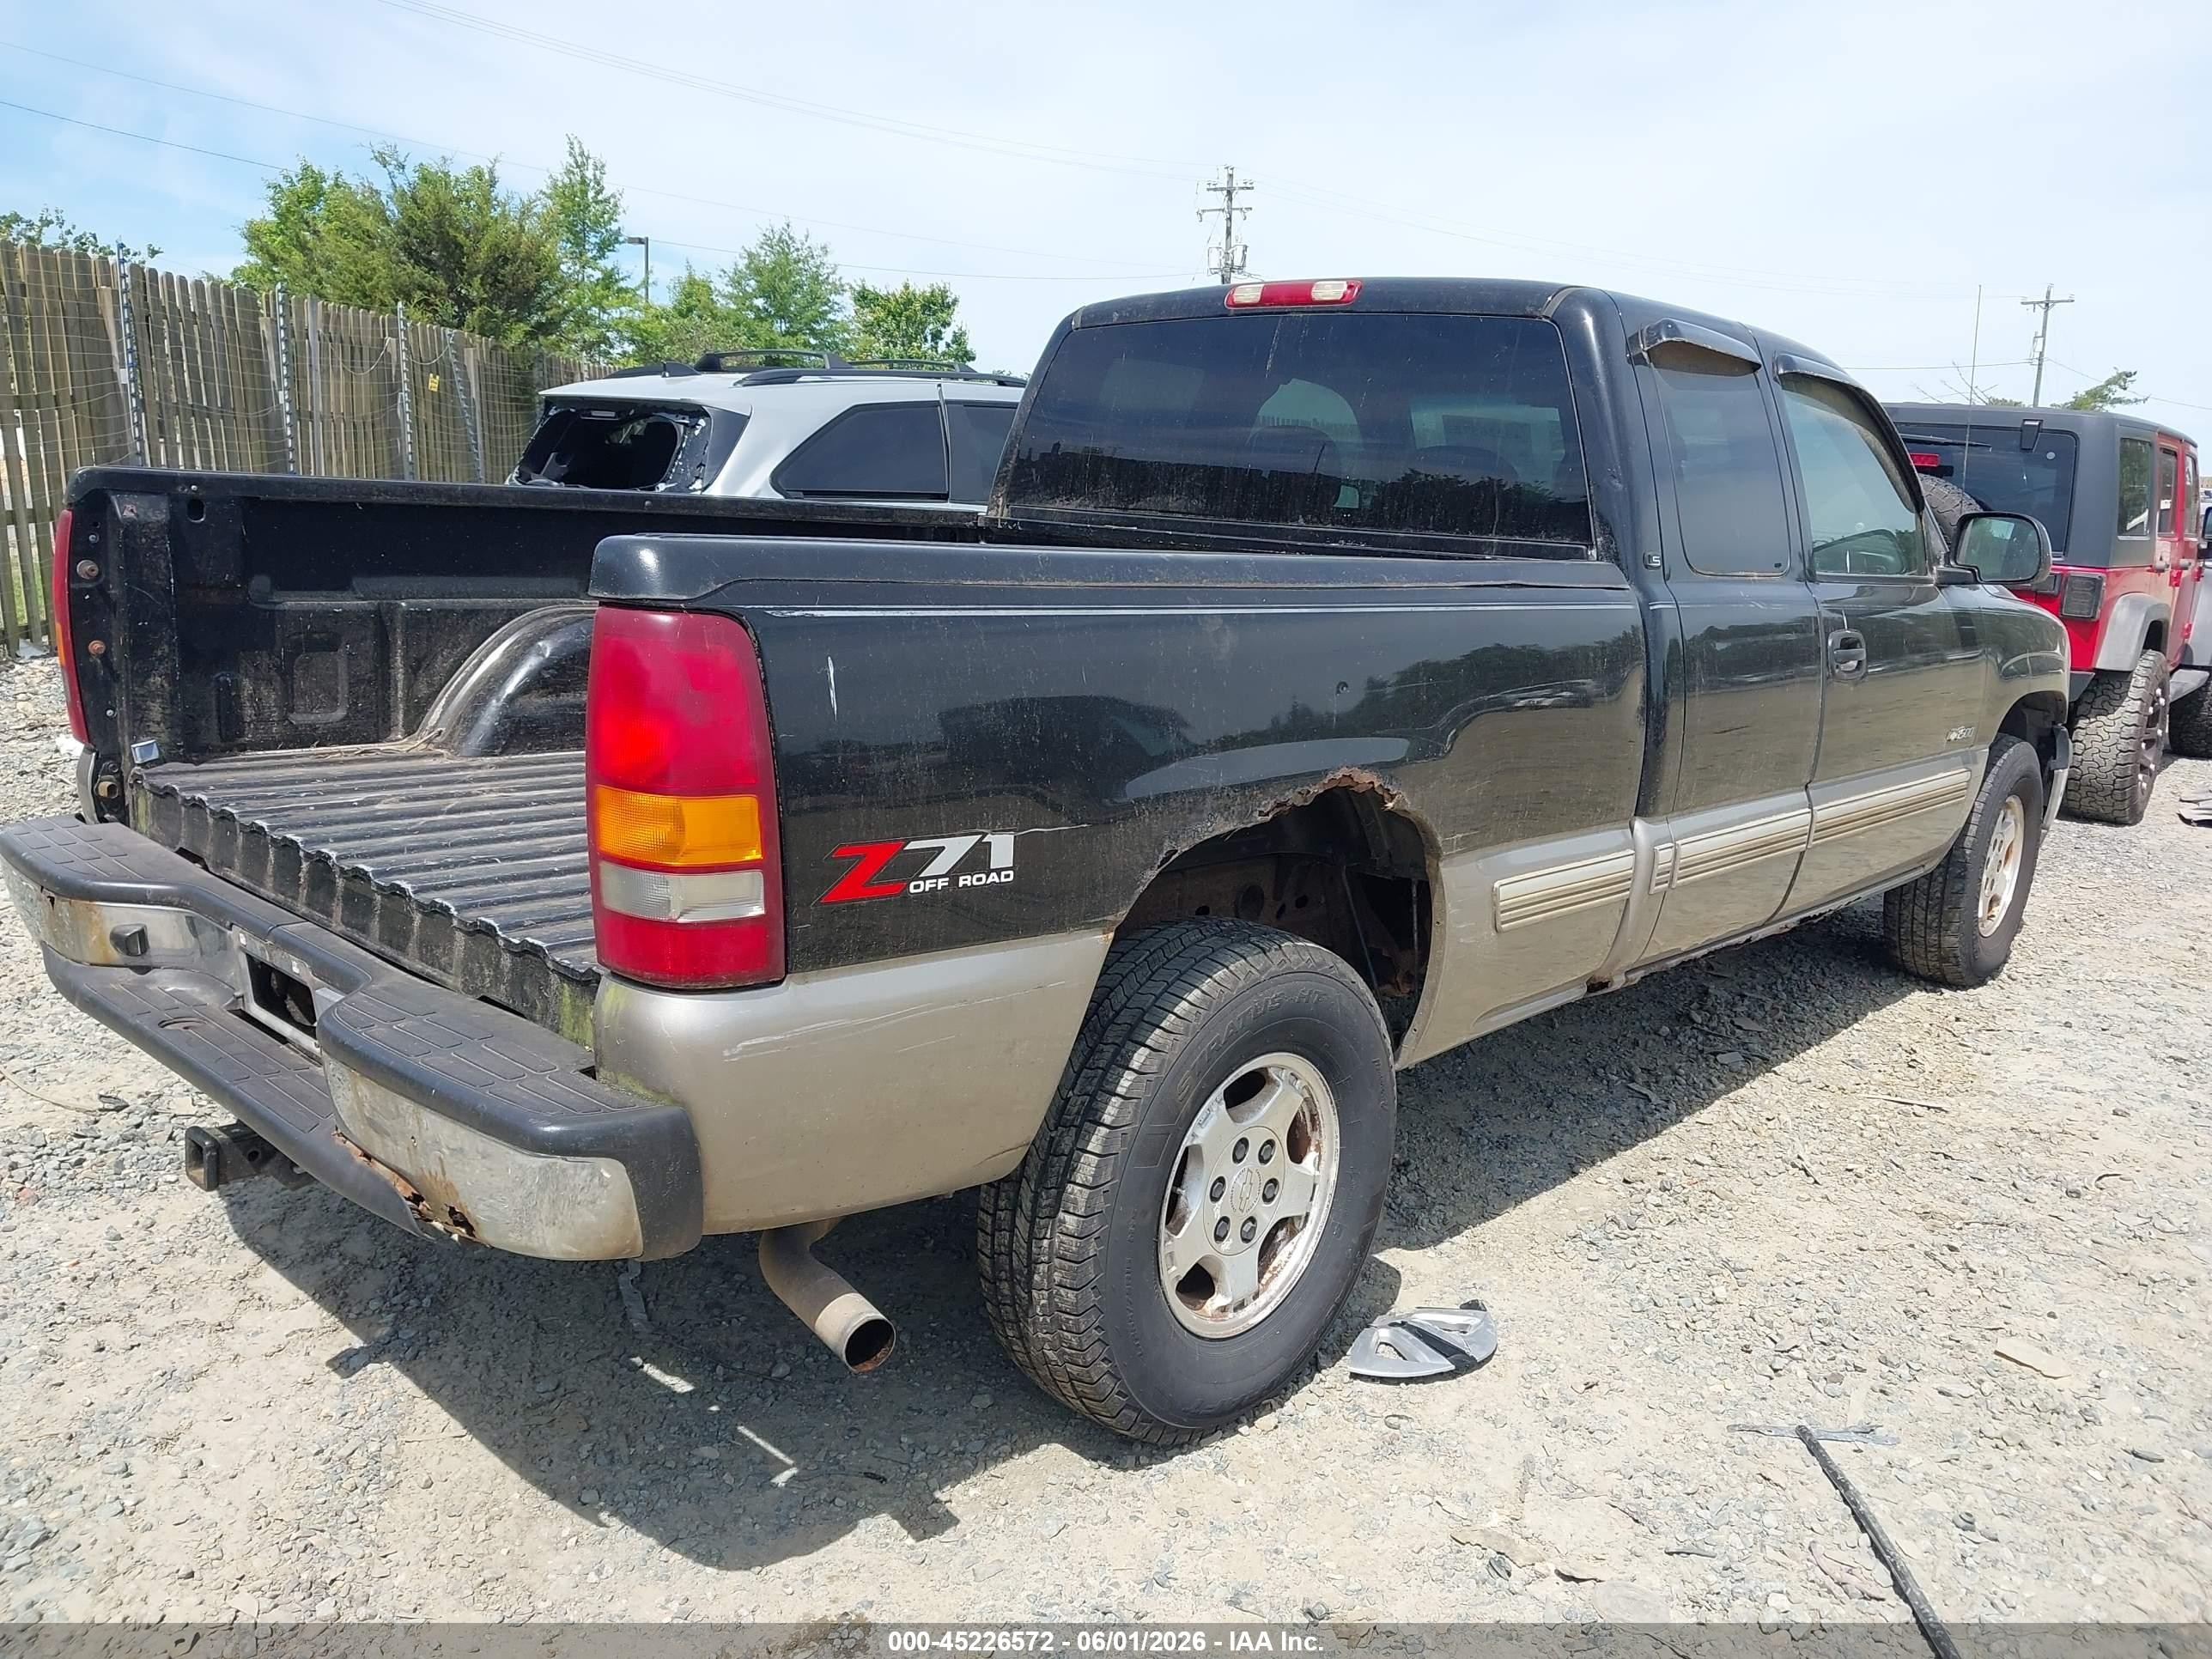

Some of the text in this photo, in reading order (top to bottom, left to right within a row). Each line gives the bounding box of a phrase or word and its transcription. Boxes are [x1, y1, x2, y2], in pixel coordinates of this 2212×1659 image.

[819, 833, 1016, 903] Z71
[908, 869, 1015, 895] OFF ROAD
